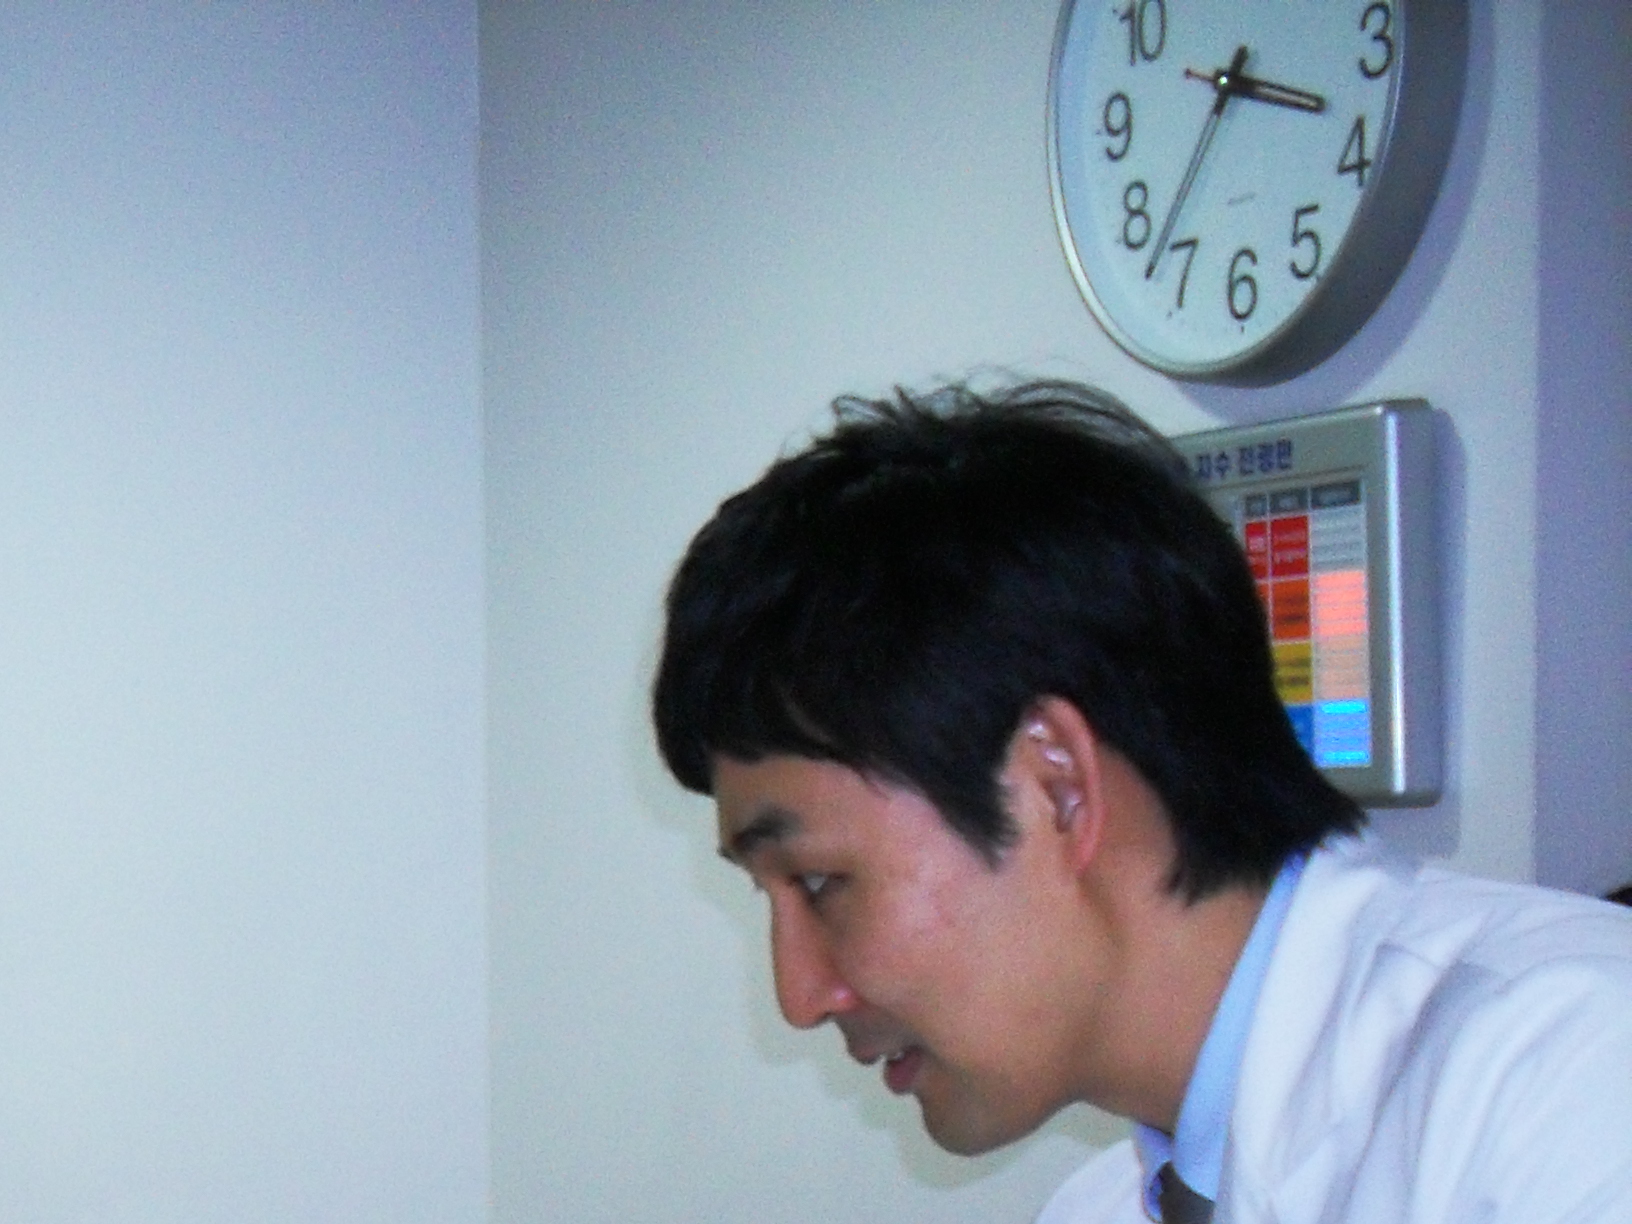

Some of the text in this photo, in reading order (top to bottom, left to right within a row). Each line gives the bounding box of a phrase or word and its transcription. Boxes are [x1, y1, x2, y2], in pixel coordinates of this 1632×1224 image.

[1118, 0, 1166, 66] 10
[1359, 2, 1394, 79] 3
[1103, 92, 1133, 161] 9
[1337, 115, 1372, 187] 4
[1122, 180, 1152, 251] 8
[1290, 204, 1323, 280] 5
[1169, 237, 1200, 310] 7
[1227, 248, 1258, 321] 6
